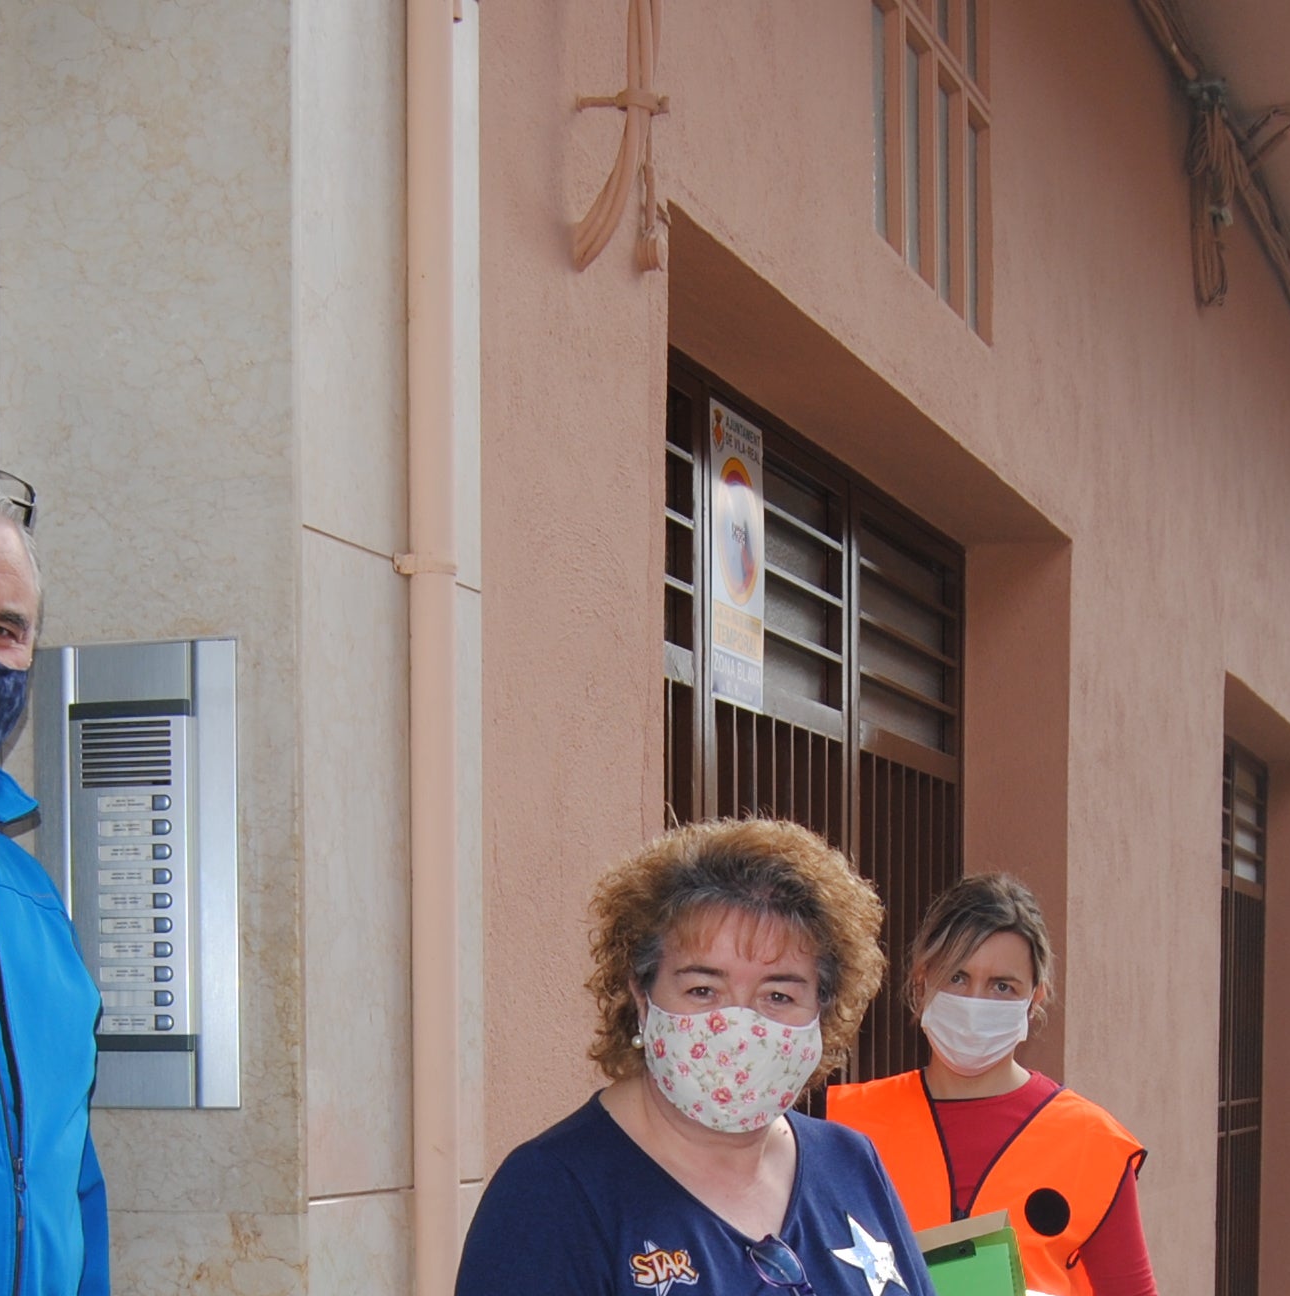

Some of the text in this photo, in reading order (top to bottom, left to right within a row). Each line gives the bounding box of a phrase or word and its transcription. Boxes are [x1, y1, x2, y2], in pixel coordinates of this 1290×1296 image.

[725, 415, 761, 447] AJUNTAMENT
[713, 651, 735, 677] ZONA
[630, 1249, 697, 1285] STAR
